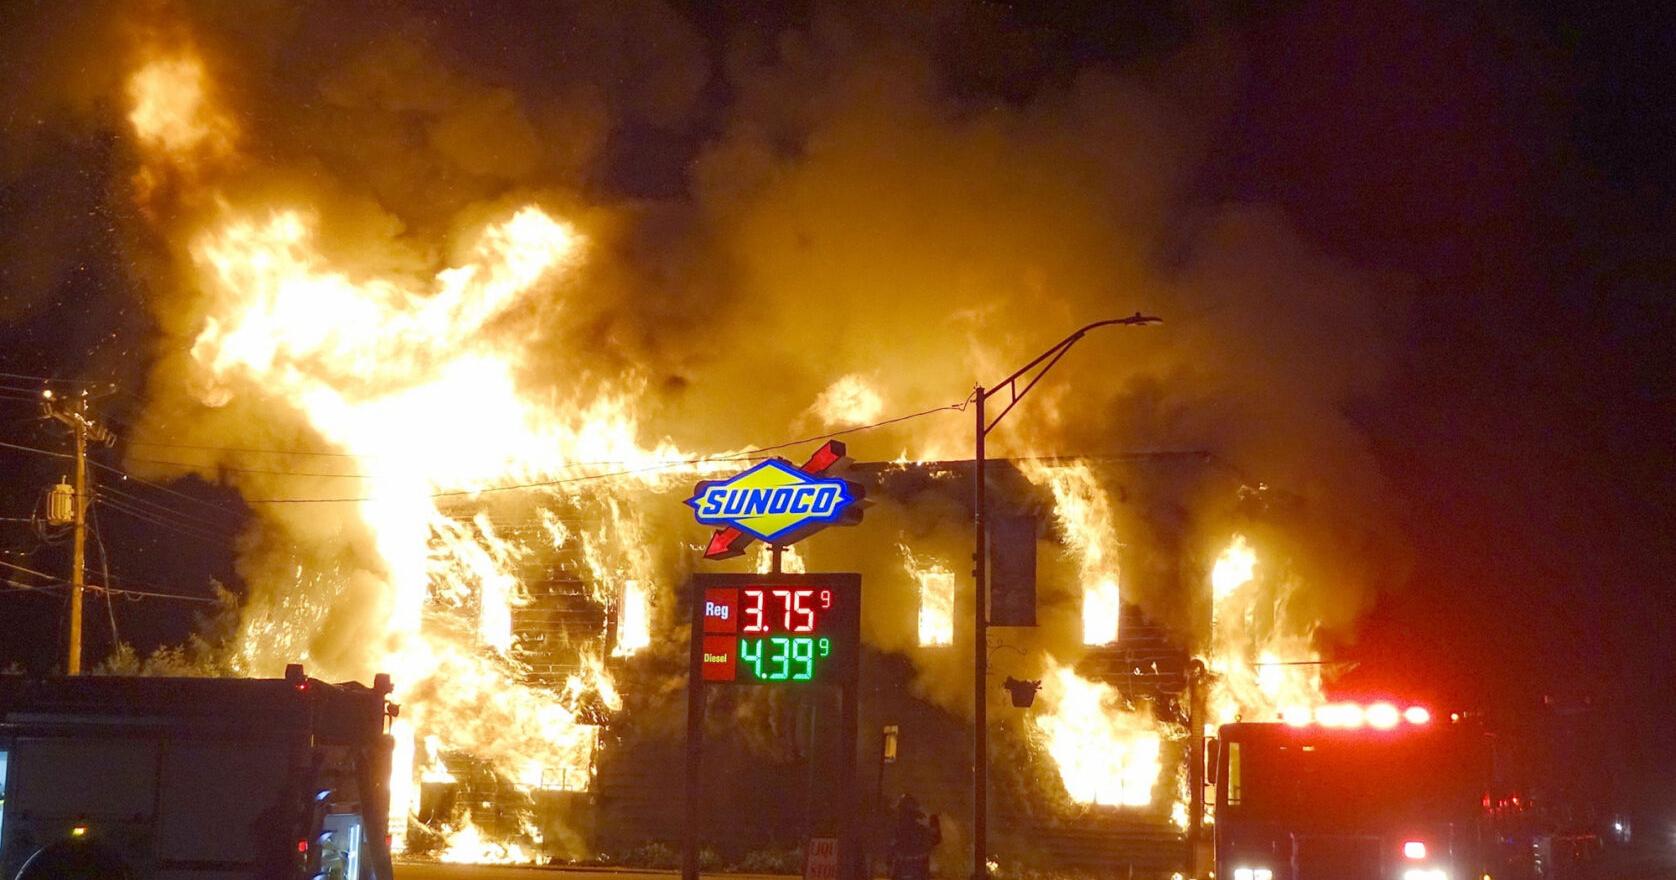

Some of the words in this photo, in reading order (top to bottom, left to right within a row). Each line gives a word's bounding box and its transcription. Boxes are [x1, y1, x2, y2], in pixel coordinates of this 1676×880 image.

[702, 487, 836, 515] SUNOCO
[705, 602, 729, 619] Reg
[743, 590, 815, 632] 3.75
[703, 653, 728, 664] Diesel
[741, 638, 814, 680] 4.39
